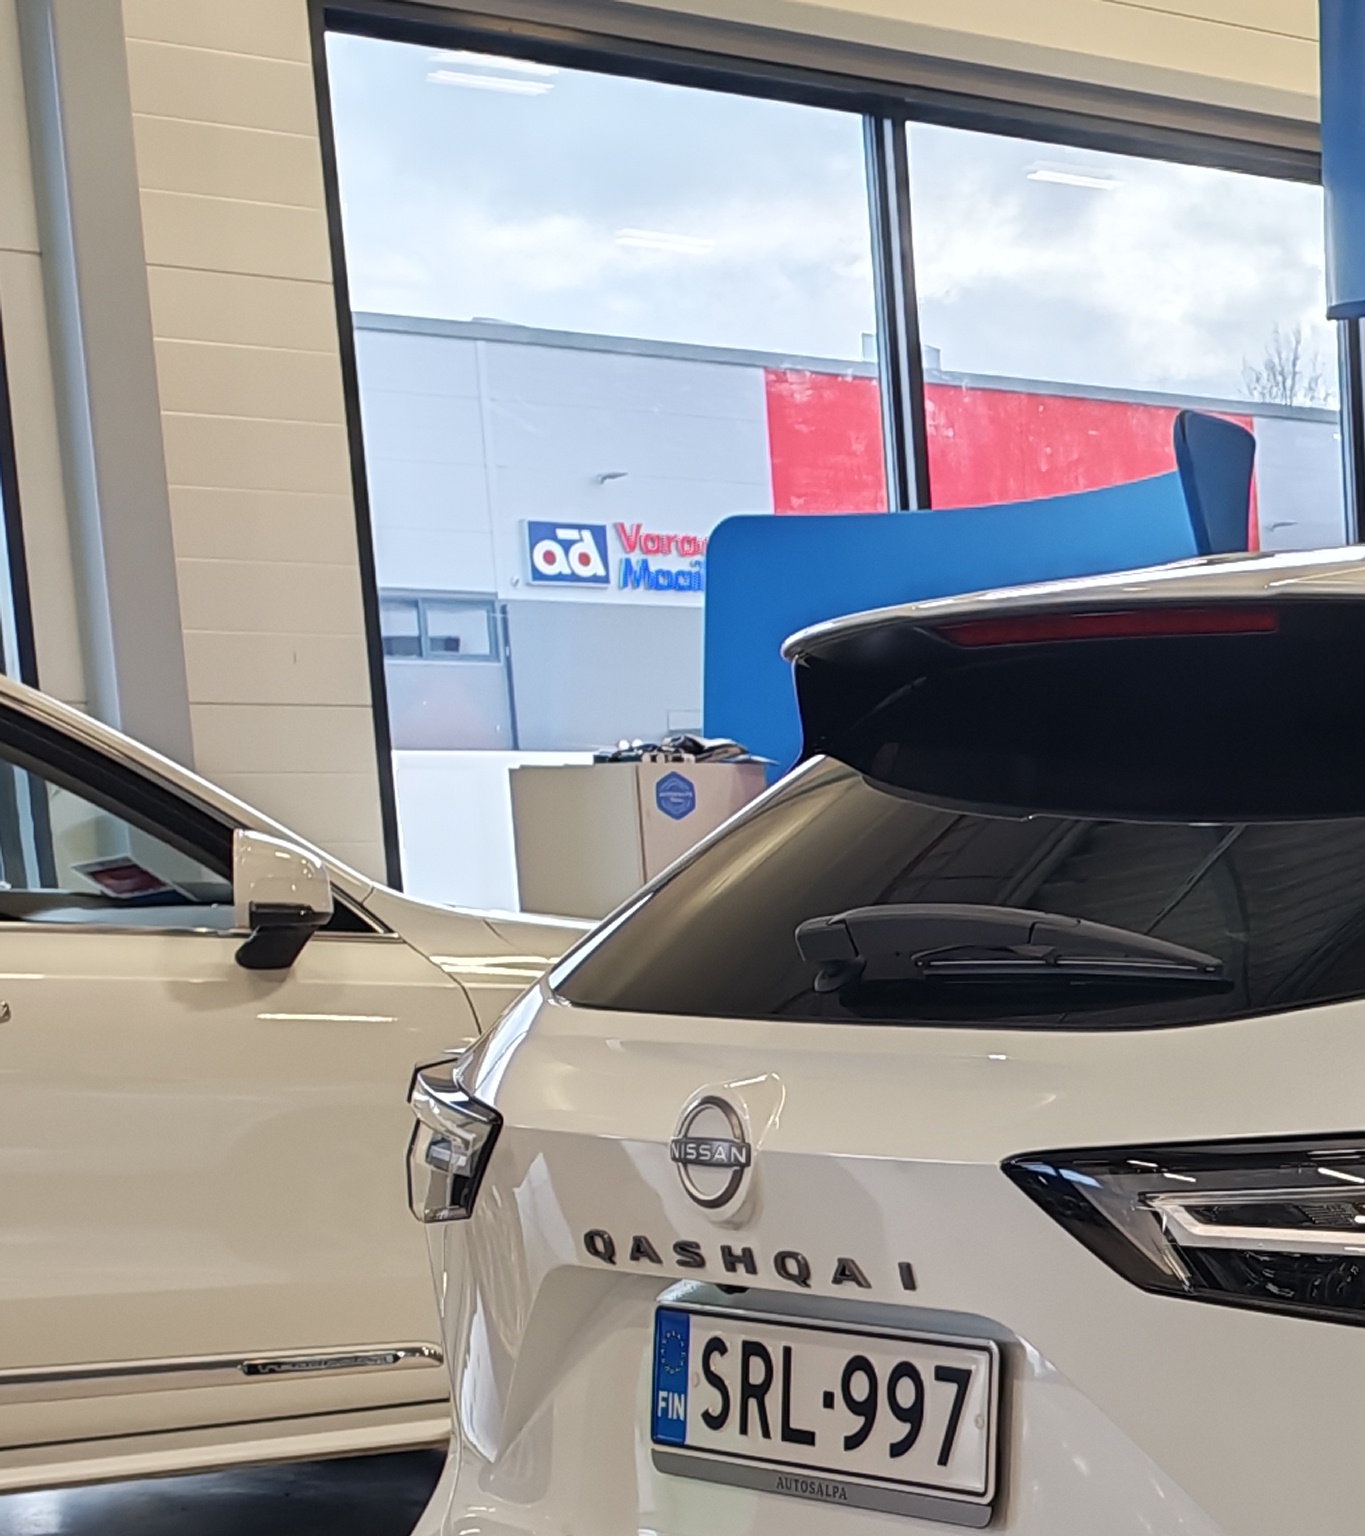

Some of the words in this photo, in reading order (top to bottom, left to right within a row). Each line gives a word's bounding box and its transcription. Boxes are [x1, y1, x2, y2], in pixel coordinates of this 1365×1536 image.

[671, 1142, 747, 1164] NISSAN
[583, 1229, 917, 1291] QASHQAI
[657, 1390, 685, 1421] FIN
[776, 1476, 848, 1500] AUTOSALPA
